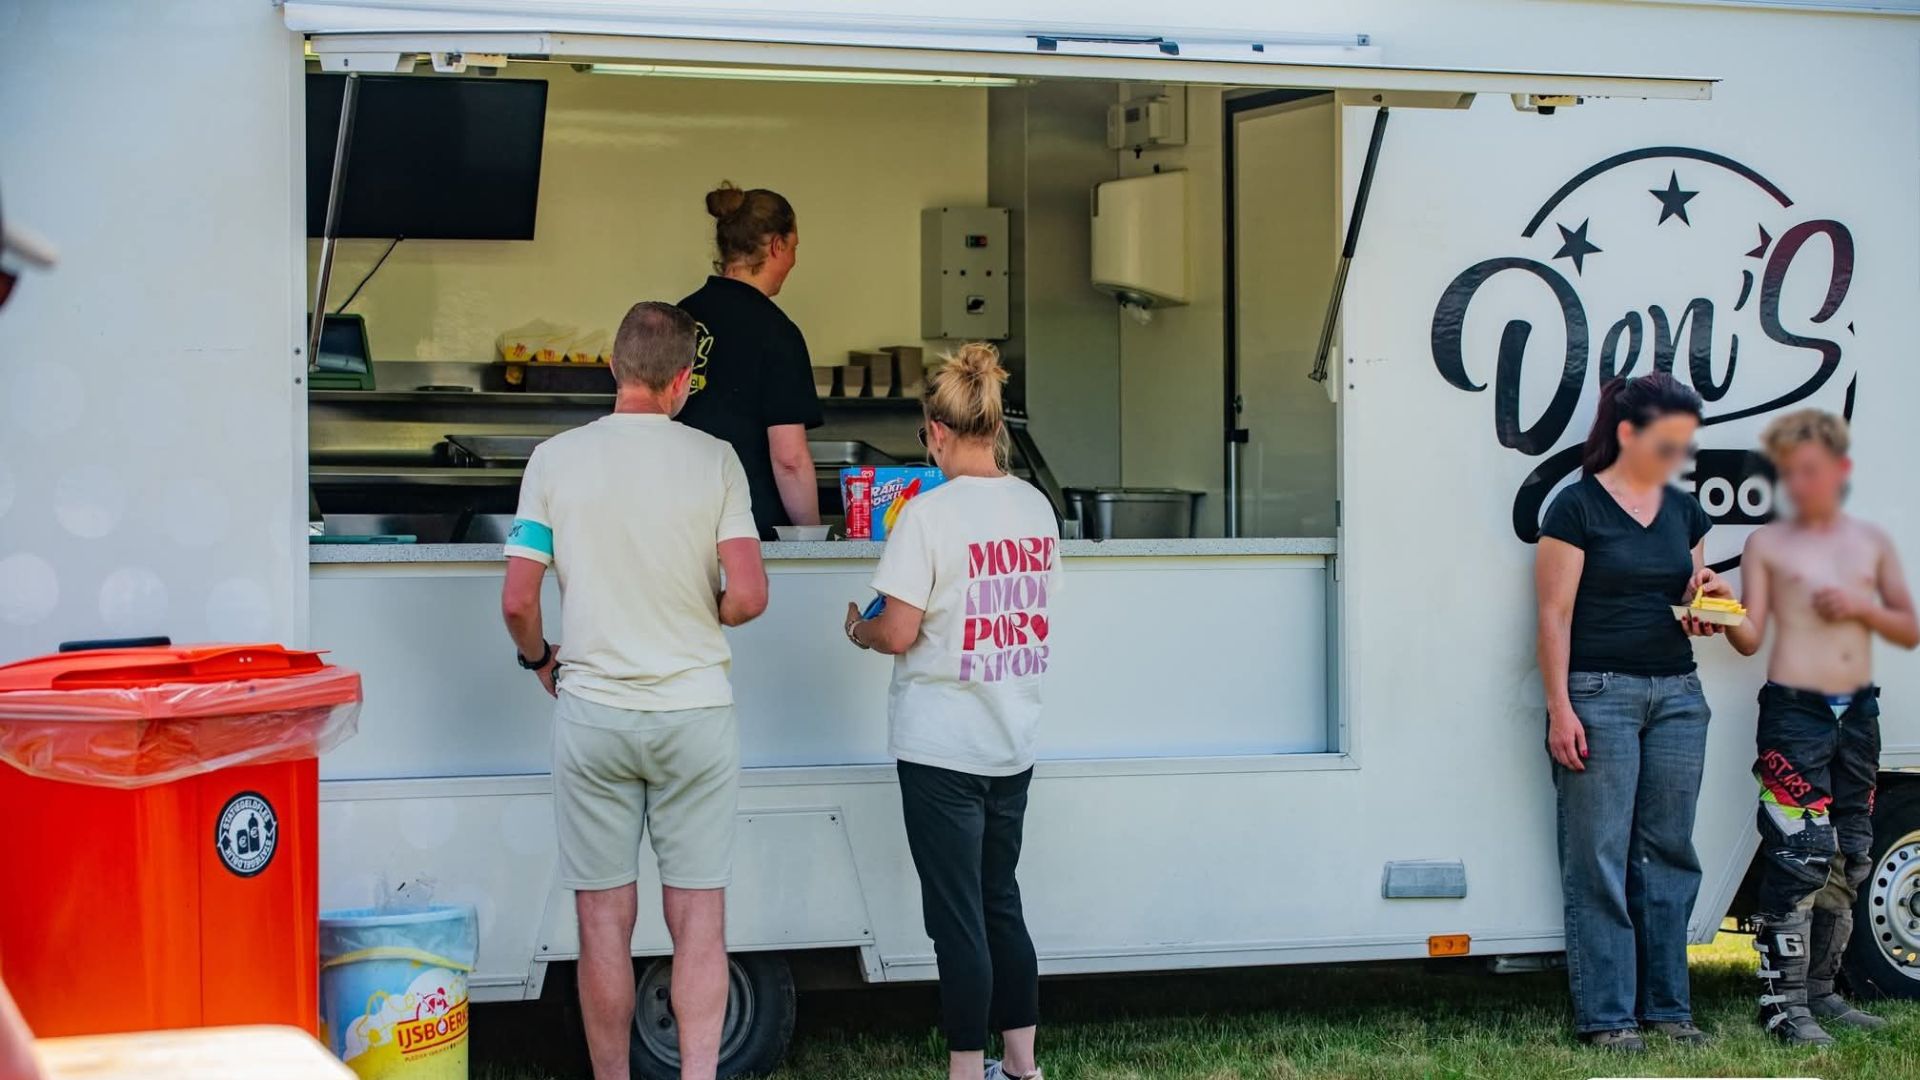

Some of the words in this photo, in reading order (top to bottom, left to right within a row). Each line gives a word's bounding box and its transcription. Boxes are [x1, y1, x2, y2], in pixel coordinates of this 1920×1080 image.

[968, 537, 1055, 578] MORE
[963, 612, 1029, 650] POR
[959, 646, 1049, 682] FAVOR
